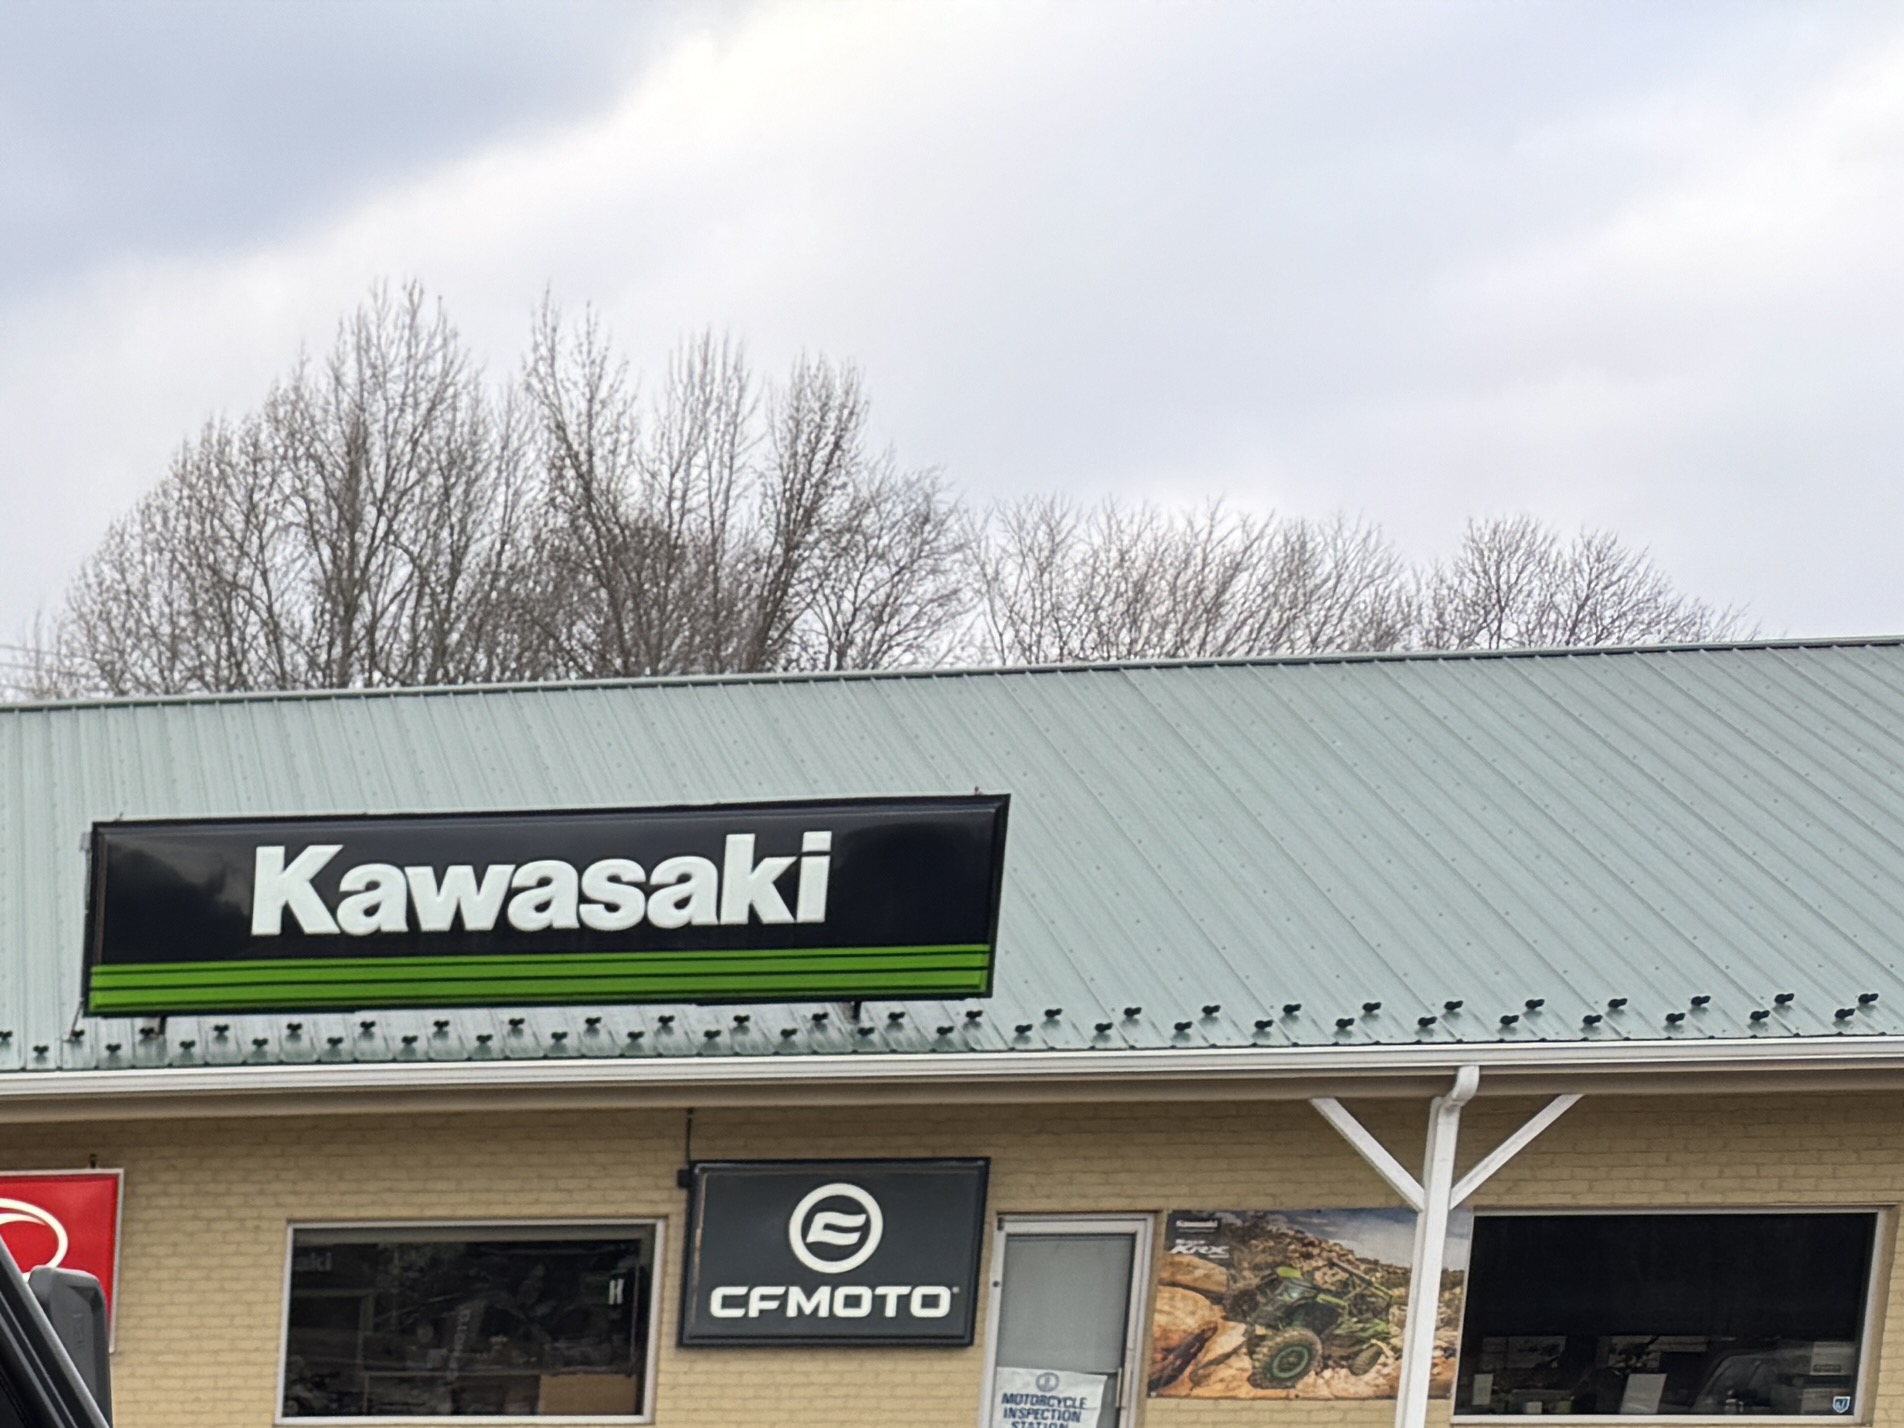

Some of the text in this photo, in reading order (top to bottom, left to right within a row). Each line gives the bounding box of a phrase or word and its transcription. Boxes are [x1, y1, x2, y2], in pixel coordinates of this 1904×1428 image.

[251, 830, 832, 936] Kawasaki
[710, 1286, 951, 1318] CFMOTO
[1001, 1392, 1088, 1410] MOTORCYCLE
[1002, 1407, 1081, 1423] INSPECTION
